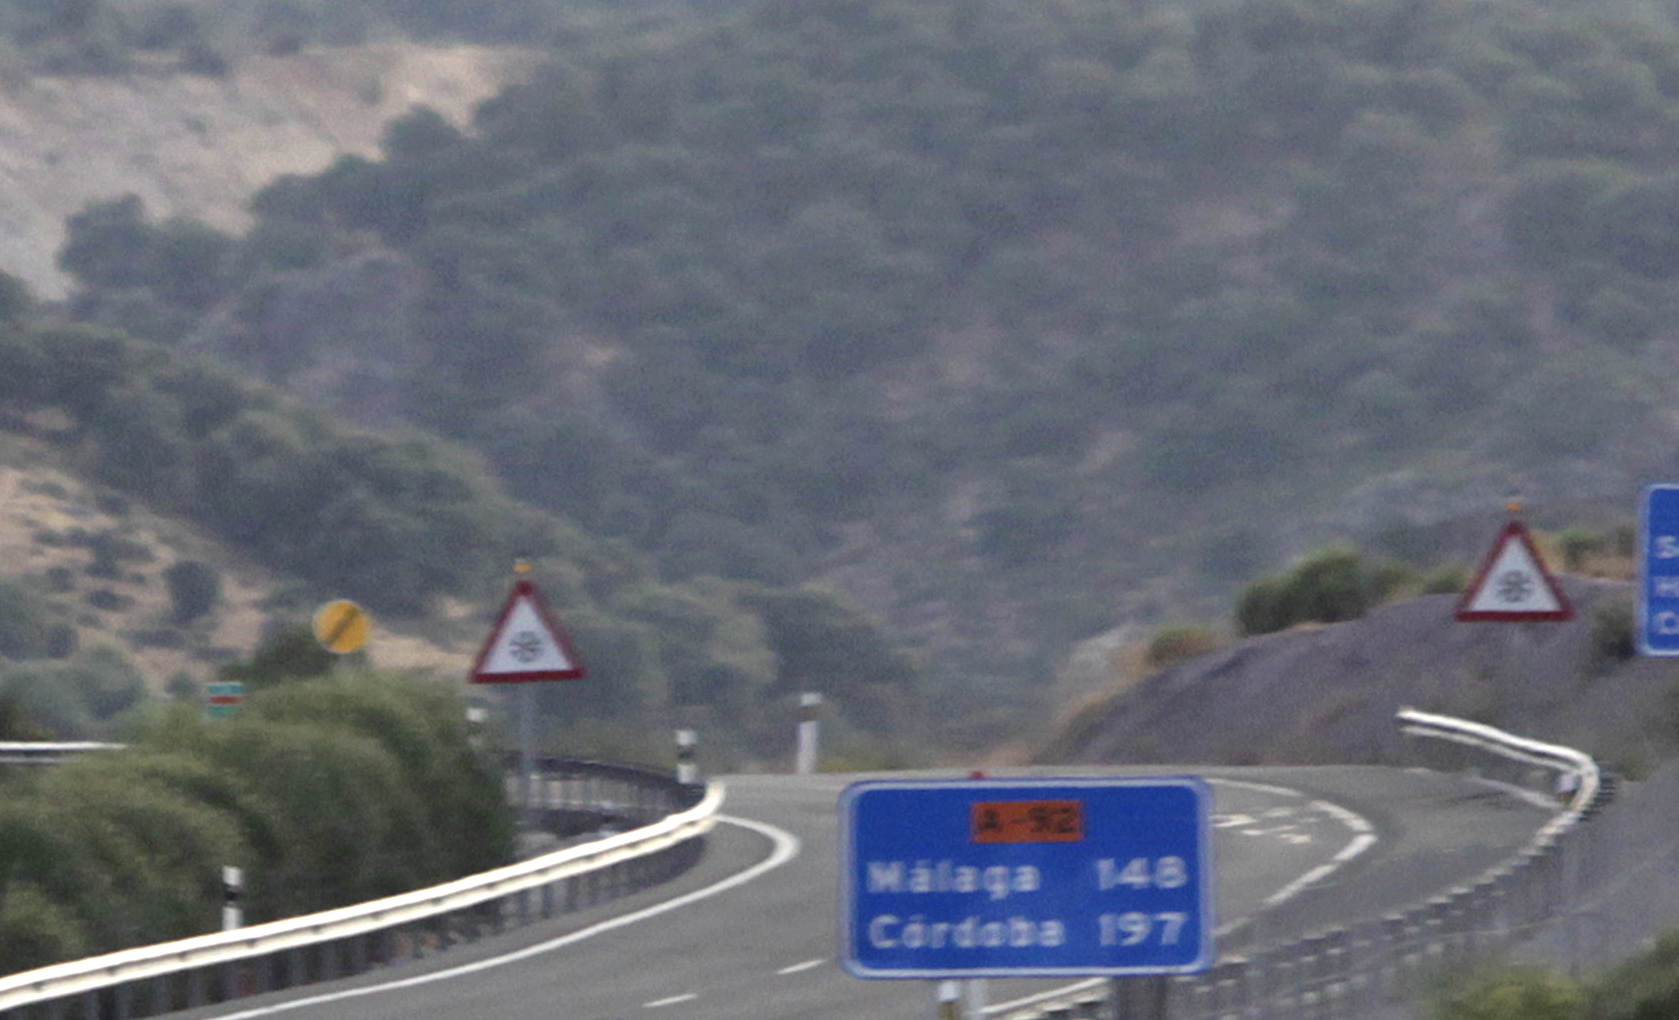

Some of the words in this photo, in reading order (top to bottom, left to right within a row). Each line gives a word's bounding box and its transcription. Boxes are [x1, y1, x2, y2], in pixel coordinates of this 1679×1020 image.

[867, 859, 1040, 900] Málaga
[1097, 856, 1187, 890] 148
[869, 914, 1065, 949] Córdoba
[1099, 912, 1188, 946] 197
